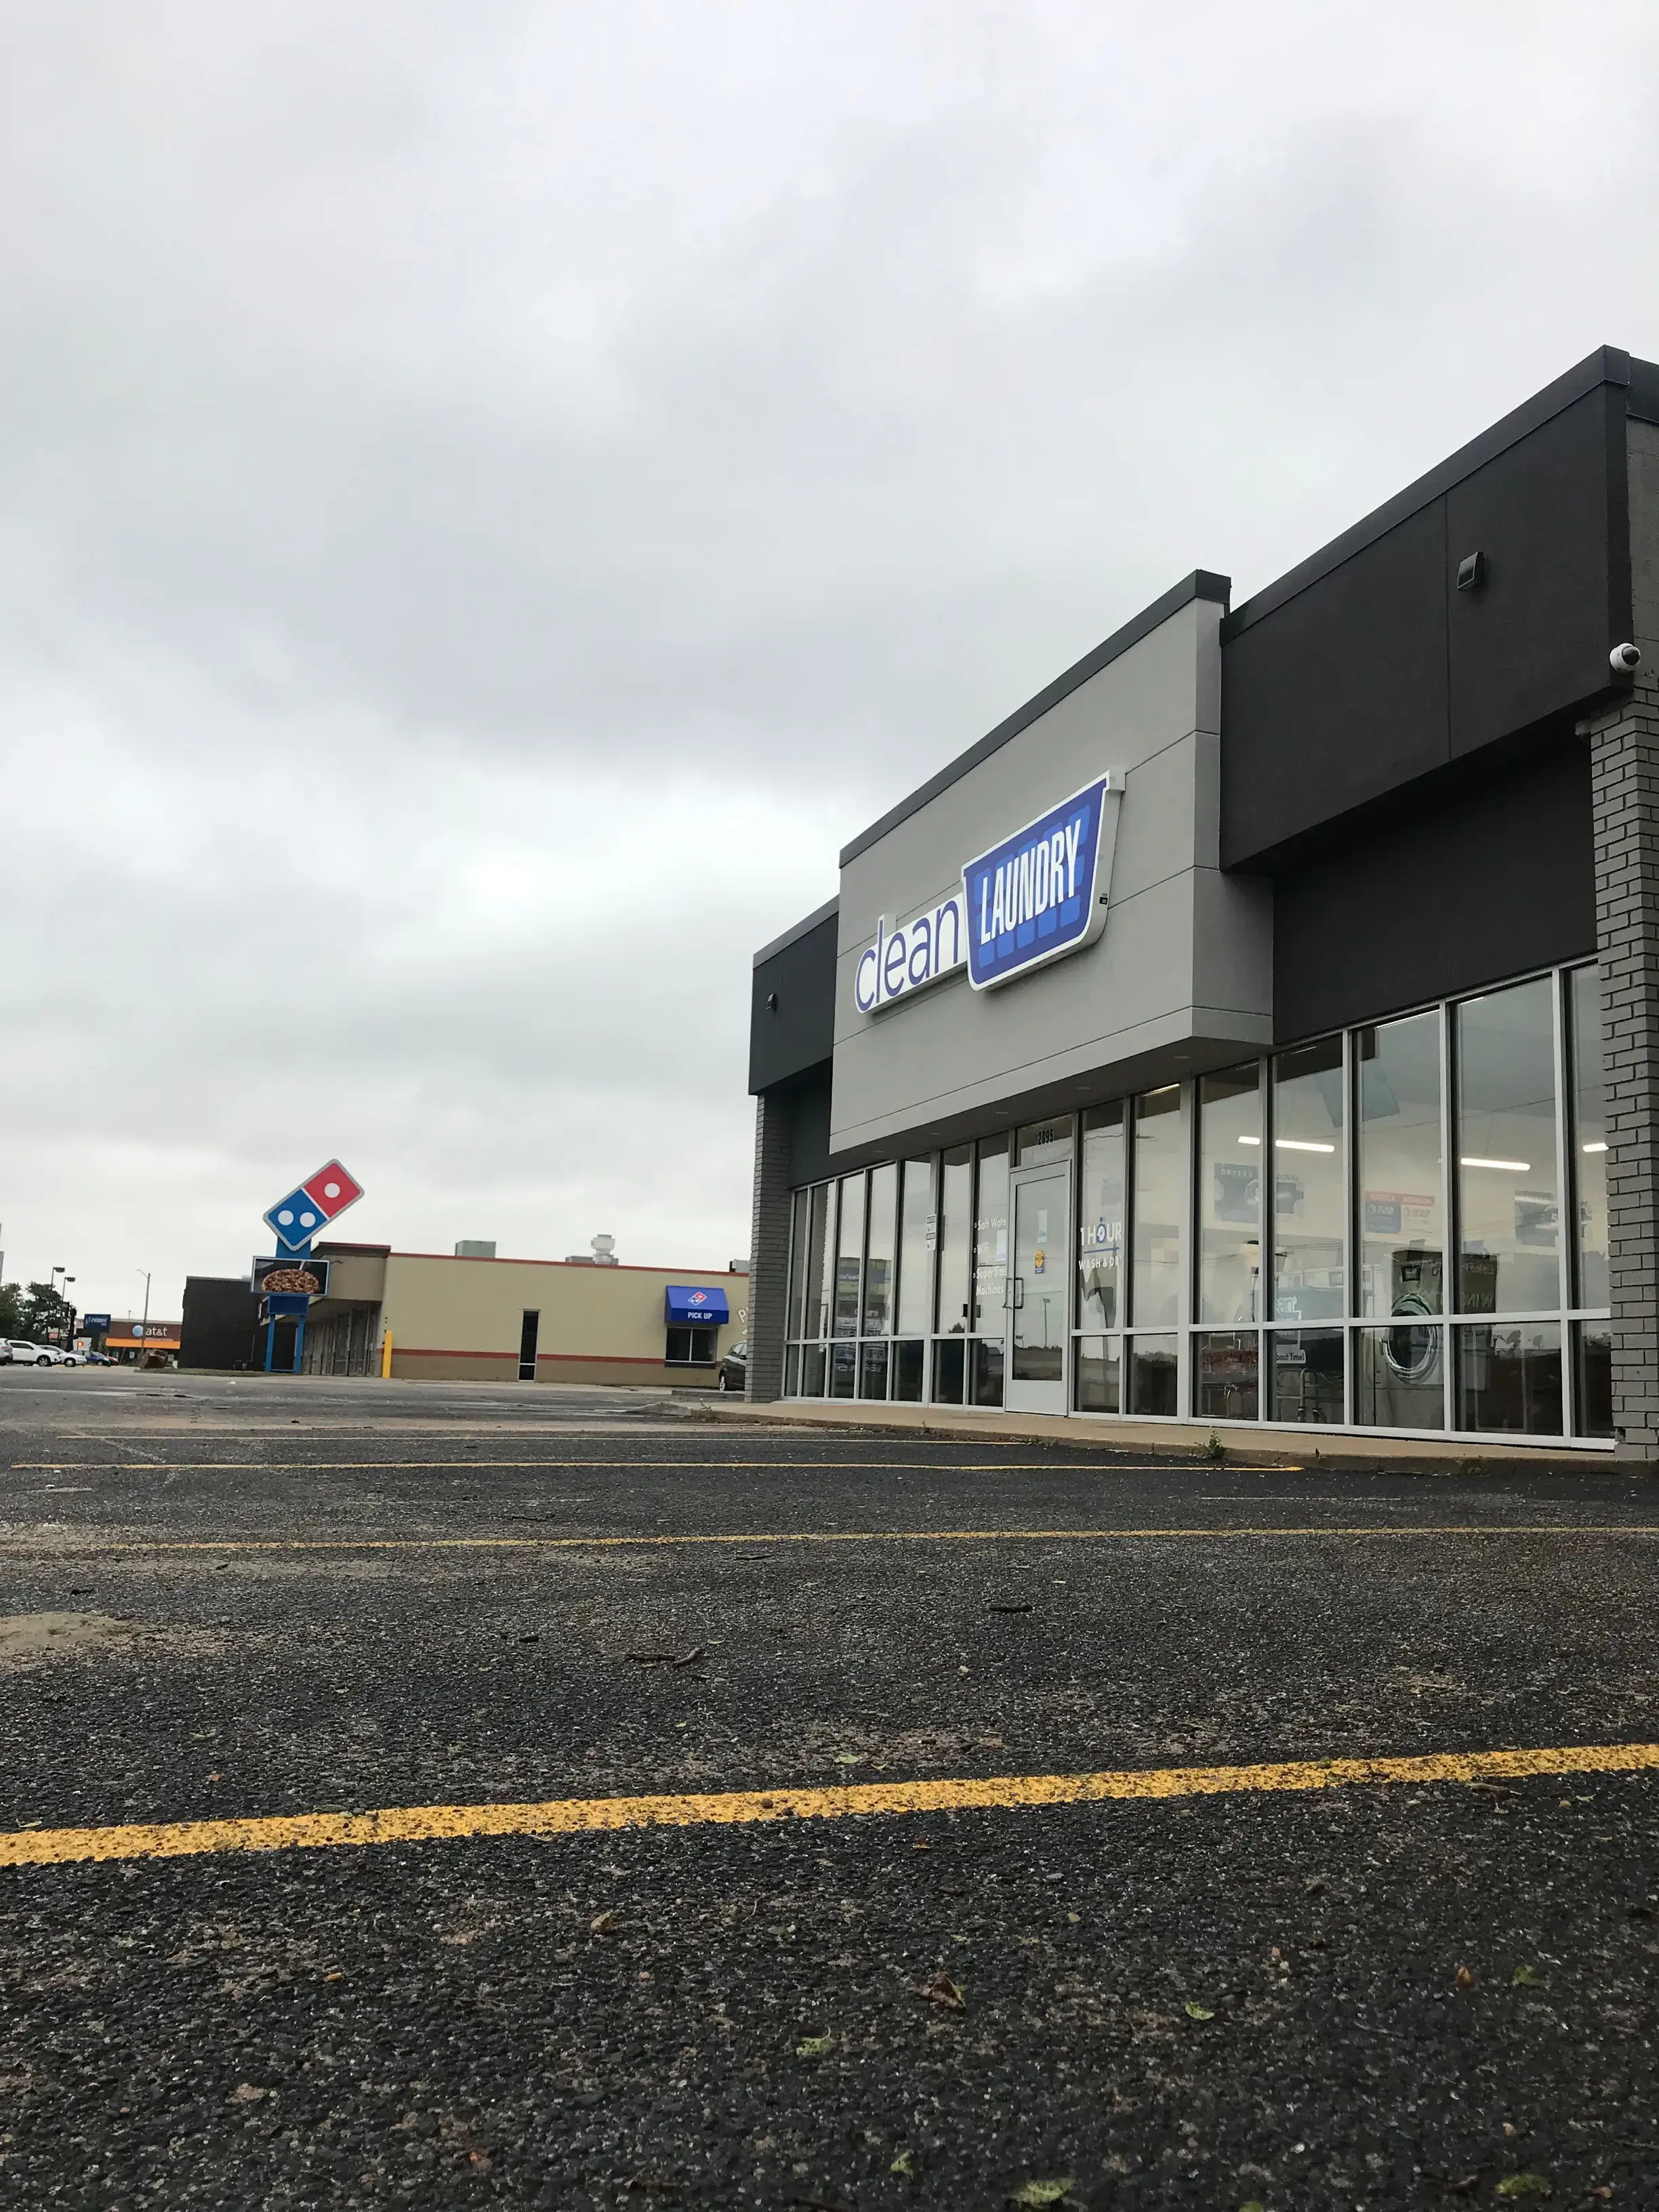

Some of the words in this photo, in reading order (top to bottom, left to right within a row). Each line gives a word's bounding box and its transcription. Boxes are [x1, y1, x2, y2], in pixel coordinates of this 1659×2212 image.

[981, 819, 1081, 945] LAUNDRY
[856, 900, 959, 1012] clean
[977, 1219, 989, 1231] Soft
[991, 1217, 1006, 1228] Wate
[1080, 1227, 1085, 1246] 1
[1087, 1221, 1122, 1245] HOUR
[1079, 1257, 1101, 1270] WASH
[1103, 1257, 1108, 1268] &
[976, 1283, 1004, 1296] Machines
[687, 1311, 702, 1319] PICK
[145, 1327, 167, 1336] at&t
